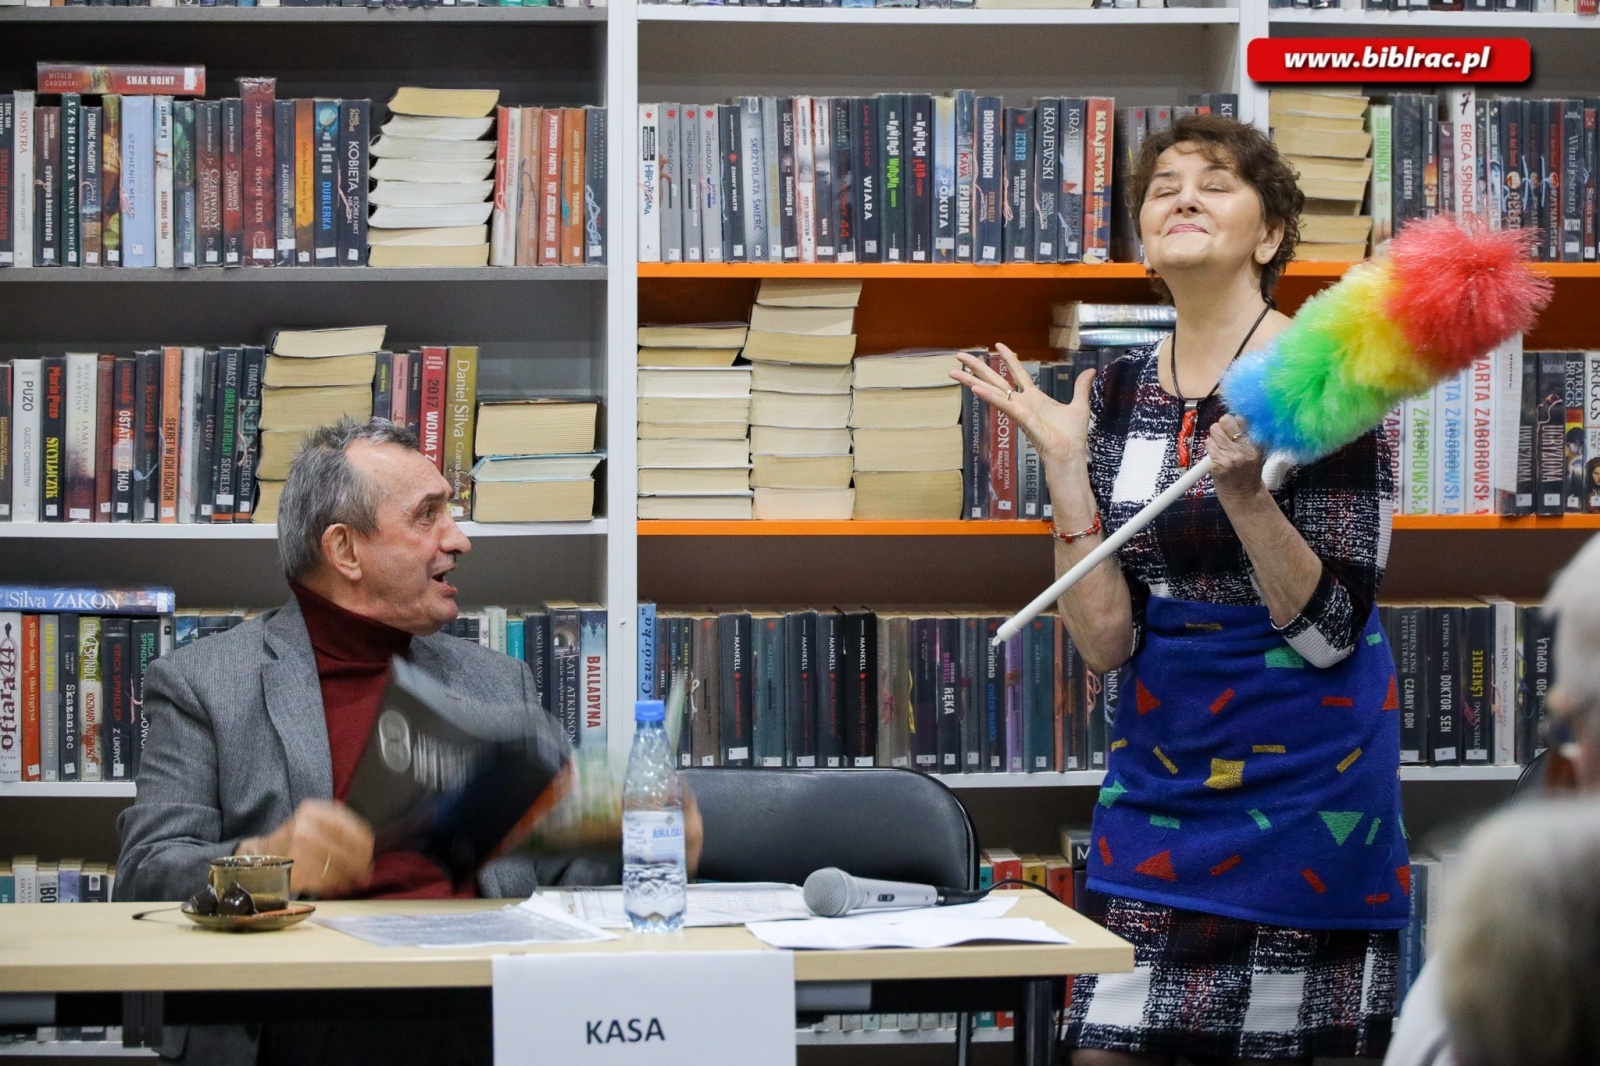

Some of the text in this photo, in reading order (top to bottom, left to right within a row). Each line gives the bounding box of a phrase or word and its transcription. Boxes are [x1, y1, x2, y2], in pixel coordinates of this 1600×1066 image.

[126, 76, 175, 86] SMAK WOJNY
[20, 110, 28, 154] SIOSTRA
[88, 113, 96, 140] CORMAC
[255, 102, 264, 157] GROBOWIEC
[548, 115, 558, 148] PATTERSON
[983, 110, 994, 178] BROADCHURCH
[1015, 132, 1026, 160] KERR
[1042, 107, 1054, 180] KRAJEWSKI
[1461, 124, 1472, 162] ERICA
[348, 141, 359, 192] KOBIETA,
[572, 130, 580, 184] JAMES PATTERSON
[750, 138, 760, 195] SKRZYDLATA
[1376, 130, 1390, 183] RUDNICKA
[1403, 158, 1412, 200] SEVERSKI
[201, 172, 210, 232] TESTAMENT
[210, 169, 220, 232] CZERWONY
[255, 165, 264, 223] KATE MOSSE
[282, 164, 290, 204] ZAGINIONA
[322, 182, 332, 230] DUBLERKA
[864, 175, 872, 221] WIARA
[940, 178, 949, 228] POKUTA
[45, 200, 54, 242] katastrofa
[572, 191, 580, 225] TROPICIEL
[840, 220, 850, 239] 44
[959, 184, 970, 235] EPIDEMIA
[1136, 308, 1168, 320] LINK
[22, 380, 34, 412] PUZO
[82, 363, 90, 414] WYŁĄCZNIK
[222, 352, 237, 456] TOMASZ OBRAZ KONTROLNY
[427, 379, 440, 408] 2017
[454, 360, 470, 438] Daniel Silva
[1566, 361, 1575, 408] BRIGGS
[1574, 361, 1584, 408] PATRICIA
[119, 410, 130, 450] OSTATNI
[164, 418, 176, 446] SEKRET
[241, 363, 258, 496] TOMASZ SEKIELSKI
[426, 411, 438, 452] WOJNA
[972, 408, 980, 454] LAGERCRANTZ
[1541, 424, 1564, 482] UGRYZIONA
[164, 456, 175, 470] ICH
[454, 442, 464, 470] Czarna
[1026, 454, 1036, 501] LEMBERG
[164, 471, 174, 501] OCZACH
[8, 590, 120, 610] Silva ZAKON
[28, 622, 36, 648] Wilbur
[84, 624, 96, 689] ERICA SPINDLER
[140, 632, 148, 674] SPINDLER
[1442, 614, 1450, 670] STEPHEN KING
[1470, 650, 1484, 697] LŚNIENIE
[1536, 637, 1550, 696] POD KOPUŁĄ
[28, 694, 36, 722] tygrysa
[86, 692, 96, 722] KOSZMARY
[567, 656, 576, 742] KATE ATKINSON
[586, 656, 601, 728] BALLADYNA
[942, 687, 954, 714] RĘKA
[1404, 678, 1414, 728] CZARNY DOM
[1440, 674, 1452, 732] DOKTOR SEN
[66, 684, 76, 750] Skazaniec
[586, 1018, 666, 1044] KASA
